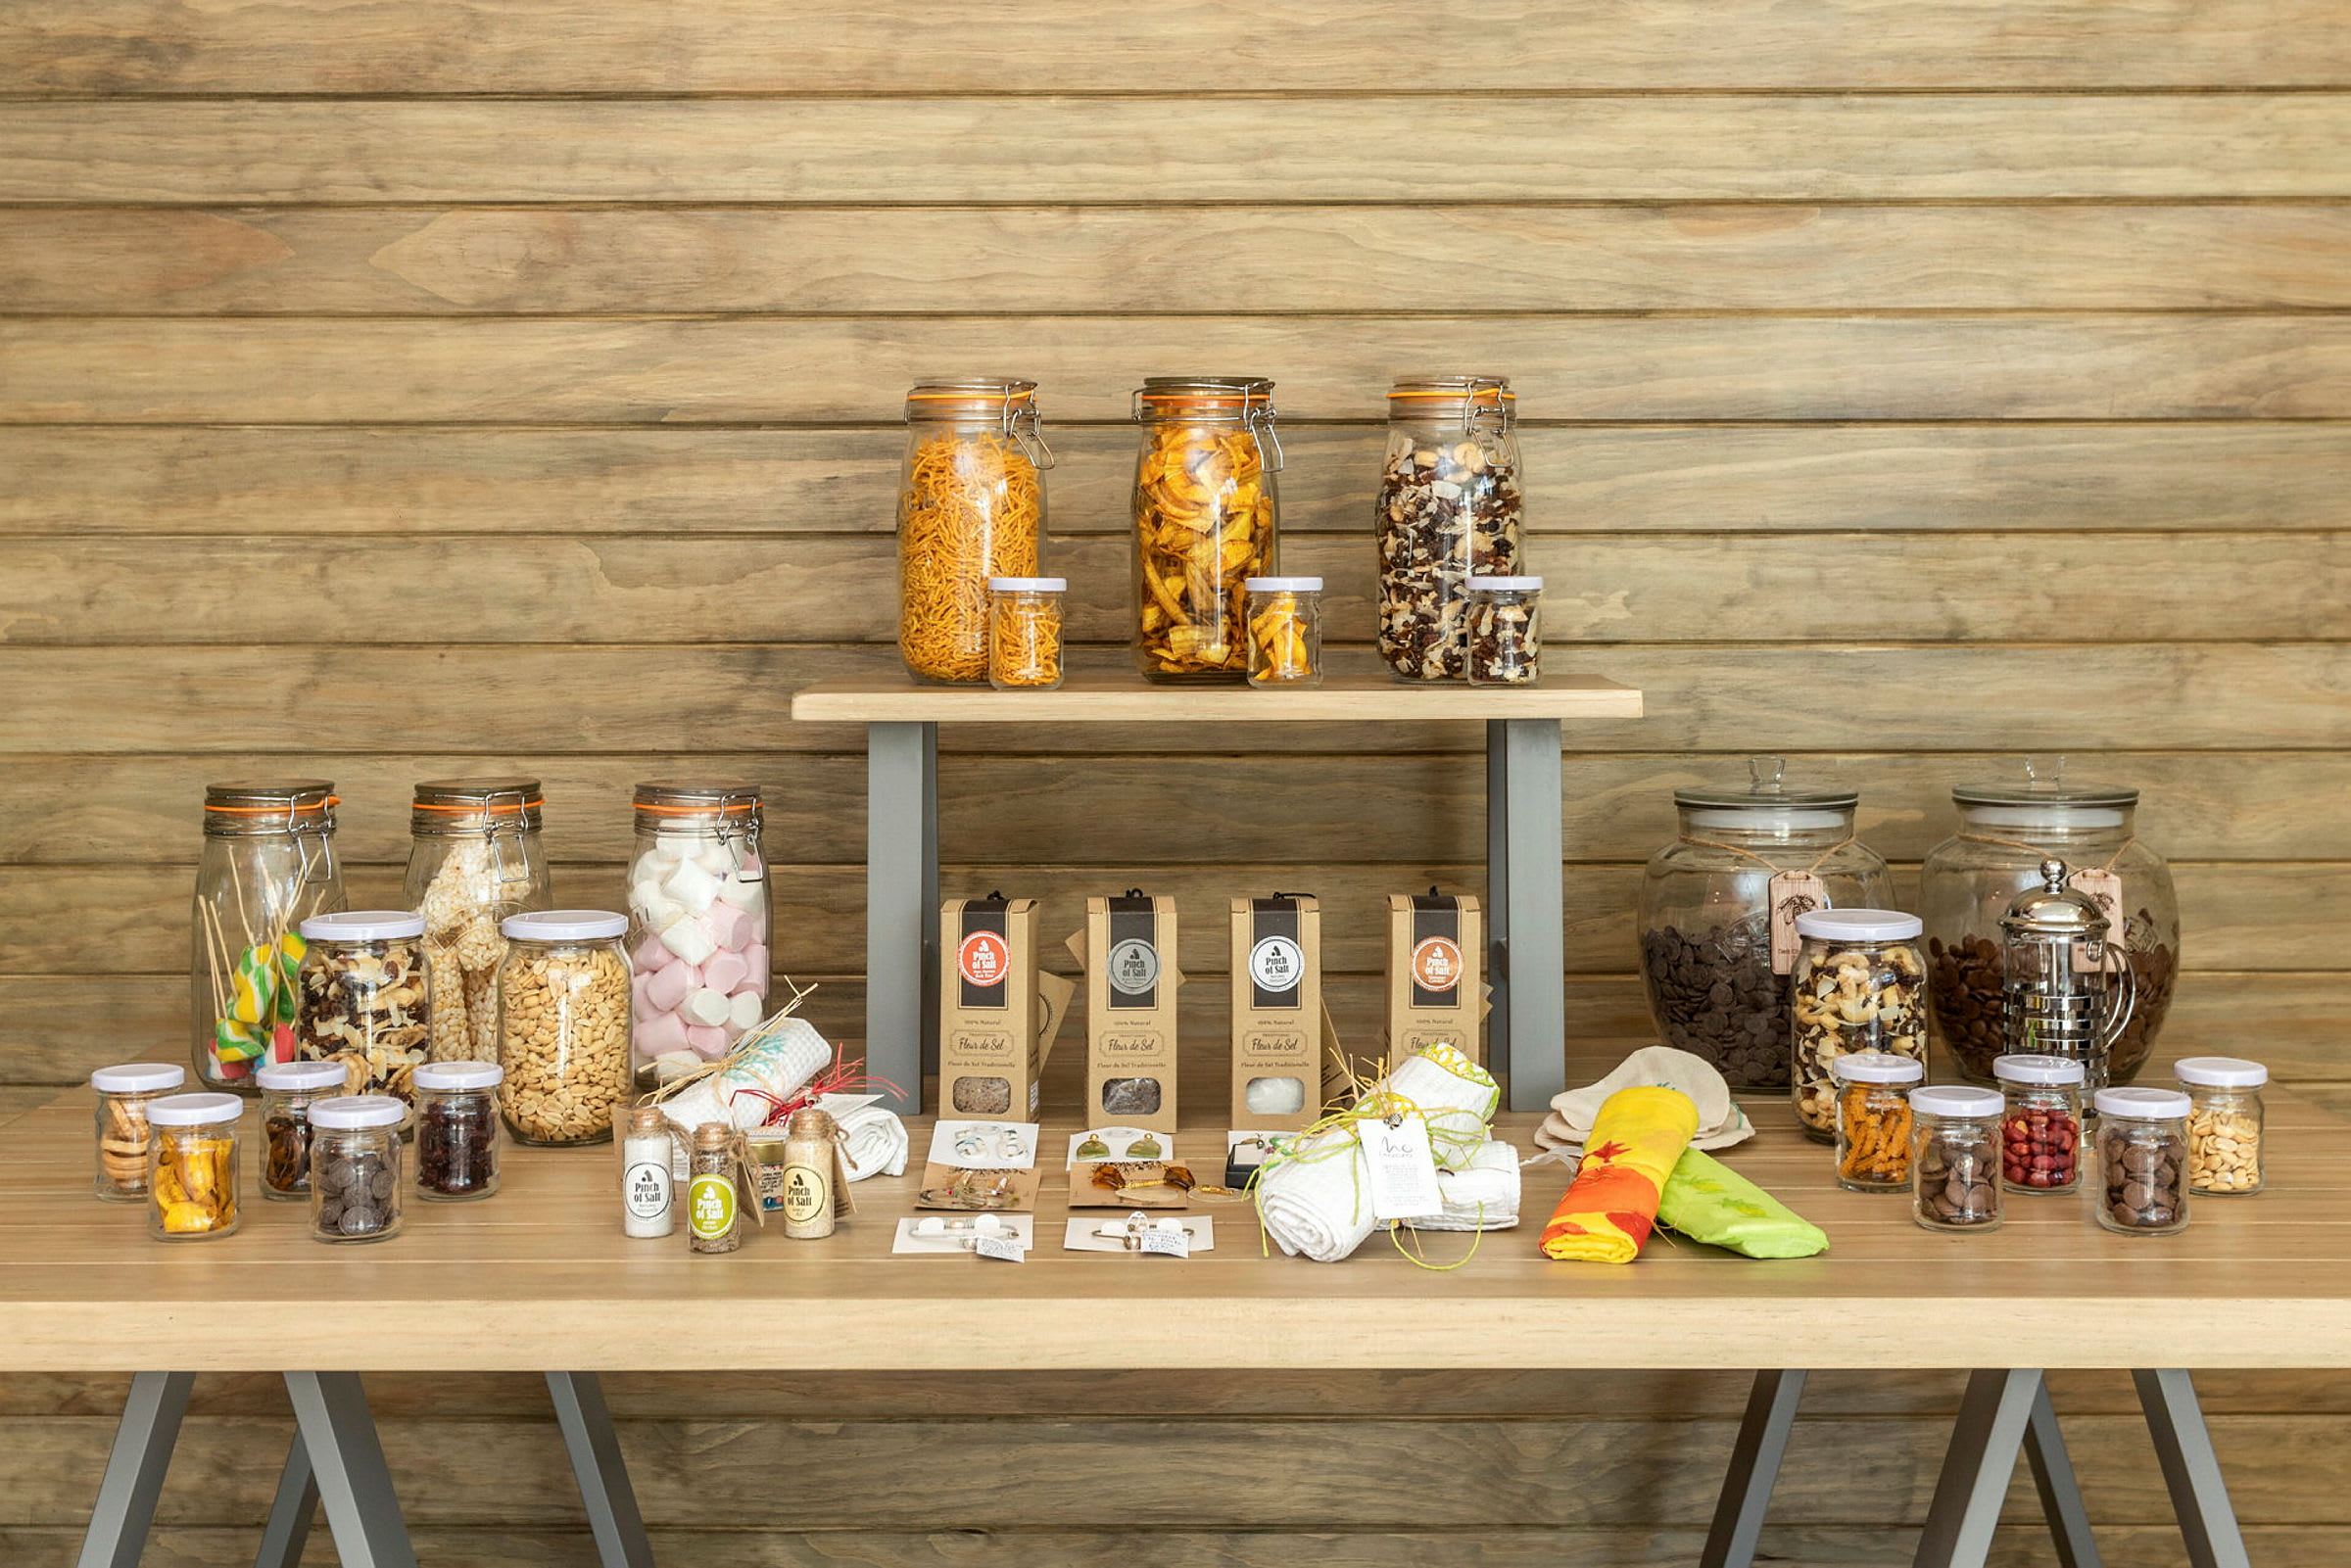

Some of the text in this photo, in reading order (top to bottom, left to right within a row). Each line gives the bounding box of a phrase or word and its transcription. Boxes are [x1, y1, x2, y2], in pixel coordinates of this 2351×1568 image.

[973, 951, 994, 960] Pinch
[972, 960, 996, 969] of Salt
[1124, 960, 1145, 969] Pinch
[1266, 957, 1287, 966] Pinch
[1132, 969, 1146, 977] Salt
[1265, 965, 1289, 974] of Salt
[1425, 966, 1450, 975] of Salt
[959, 1037, 1005, 1051] Fleur de Sel
[1108, 1038, 1155, 1051] Fleur de Sel
[1252, 1038, 1298, 1051] Fleur de Sel
[636, 1182, 659, 1192] Pinch
[789, 1186, 810, 1195] Pinch
[634, 1193, 660, 1203] of Salt
[788, 1196, 811, 1206] of Salt
[697, 1199, 722, 1209] Pinch
[696, 1209, 723, 1219] of Salt
